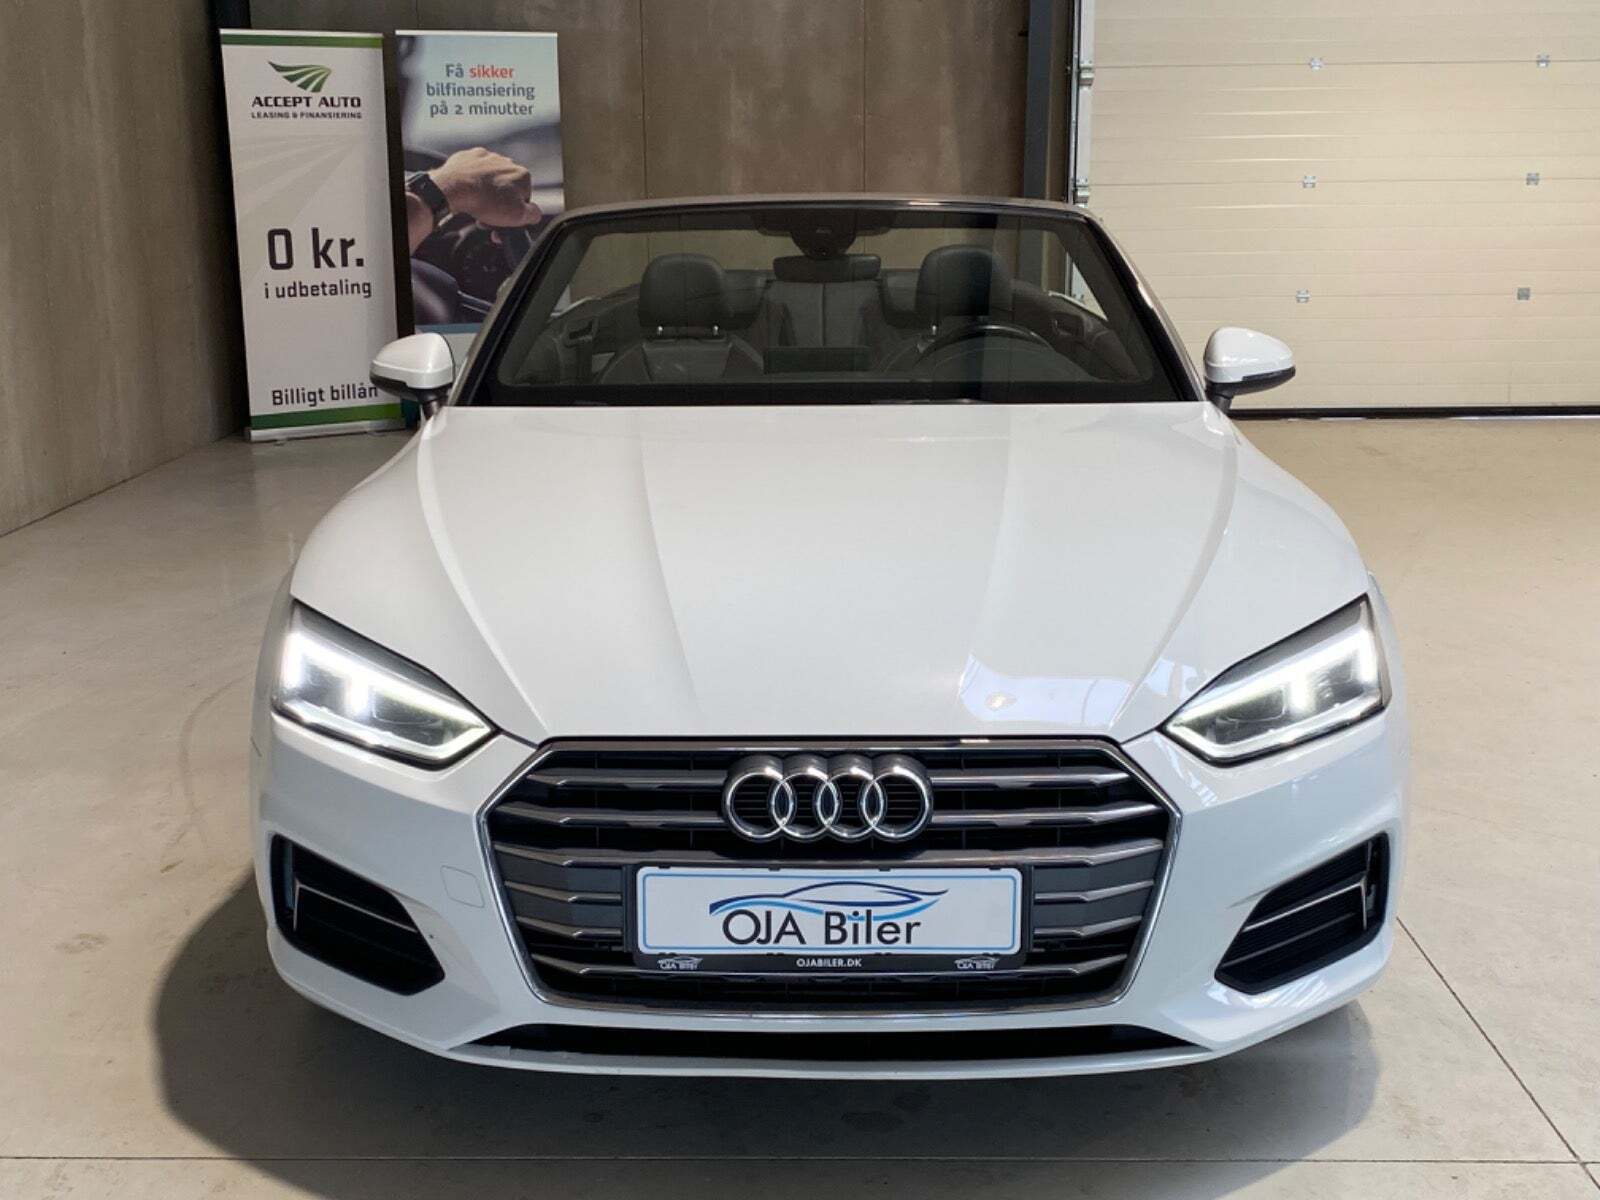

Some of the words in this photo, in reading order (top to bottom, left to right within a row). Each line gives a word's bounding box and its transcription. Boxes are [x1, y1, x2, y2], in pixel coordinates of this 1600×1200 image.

[445, 63, 464, 78] Få
[469, 64, 514, 78] sikker
[426, 82, 535, 101] bilfinansiering
[251, 96, 312, 107] ACCEPT
[318, 96, 361, 108] AUTO
[430, 100, 449, 118] på
[455, 104, 464, 115] 2
[469, 101, 534, 115] minutter
[251, 111, 289, 119] LEASING
[300, 111, 362, 119] FINANSIERING
[267, 228, 294, 270] 0
[311, 226, 364, 269] kr.
[264, 282, 269, 299] i
[275, 278, 372, 299] udbetaling
[271, 387, 325, 407] Billigt
[329, 382, 378, 401] billån
[721, 908, 806, 946] OJA
[824, 910, 922, 945] Biler
